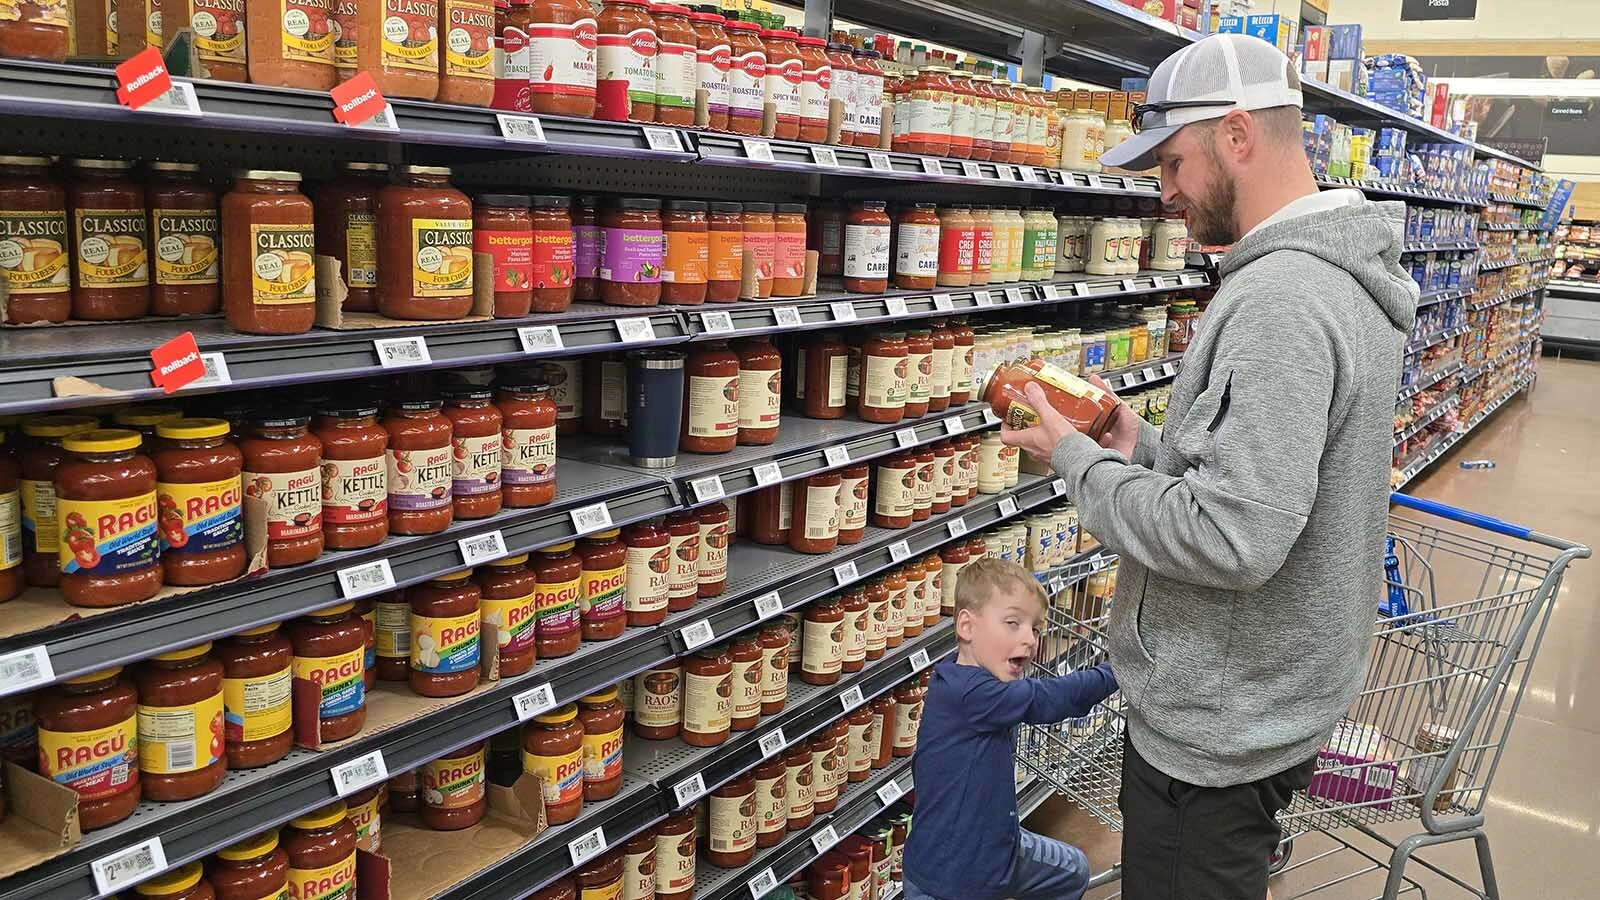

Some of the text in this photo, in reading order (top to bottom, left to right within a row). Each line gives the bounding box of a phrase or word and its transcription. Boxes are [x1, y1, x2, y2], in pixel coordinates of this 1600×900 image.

[386, 25, 406, 34] REAL
[450, 37, 469, 45] REAL
[126, 65, 164, 93] Rollback
[342, 88, 377, 113] Rollback
[0, 219, 65, 236] CLASSICO
[83, 217, 146, 233] CLASSICO
[160, 217, 217, 232] CLASSICO
[258, 232, 315, 248] CLASSICO
[83, 245, 106, 255] REAL
[160, 244, 182, 254] REAL
[419, 254, 441, 264] REAL
[9, 263, 58, 282] FOUR CHEESE
[95, 260, 138, 277] FOUR CHEESE
[171, 264, 189, 274] FOUR
[257, 262, 281, 272] REAL
[433, 274, 451, 284] FOUR
[269, 283, 288, 293] FOUR
[161, 352, 198, 376] Rollback
[520, 441, 554, 461] KETTLE
[417, 462, 451, 485] KETTLE
[342, 473, 384, 495] KETTLE
[277, 485, 320, 510] KETTLE
[345, 512, 372, 521] MARINARA
[212, 526, 230, 537] SAUCE
[280, 525, 308, 537] MARINARA
[126, 544, 146, 557] SAUCE
[597, 588, 621, 601] CHUNKY
[542, 603, 569, 616] CHUNKY
[451, 637, 475, 653] CHUNKY
[322, 678, 354, 697] CHUNKY
[644, 693, 679, 706] RAO'S
[57, 729, 126, 771] RAGÚ
[77, 764, 99, 779] World
[86, 776, 105, 788] MEAT
[448, 777, 475, 792] CHUNKY
